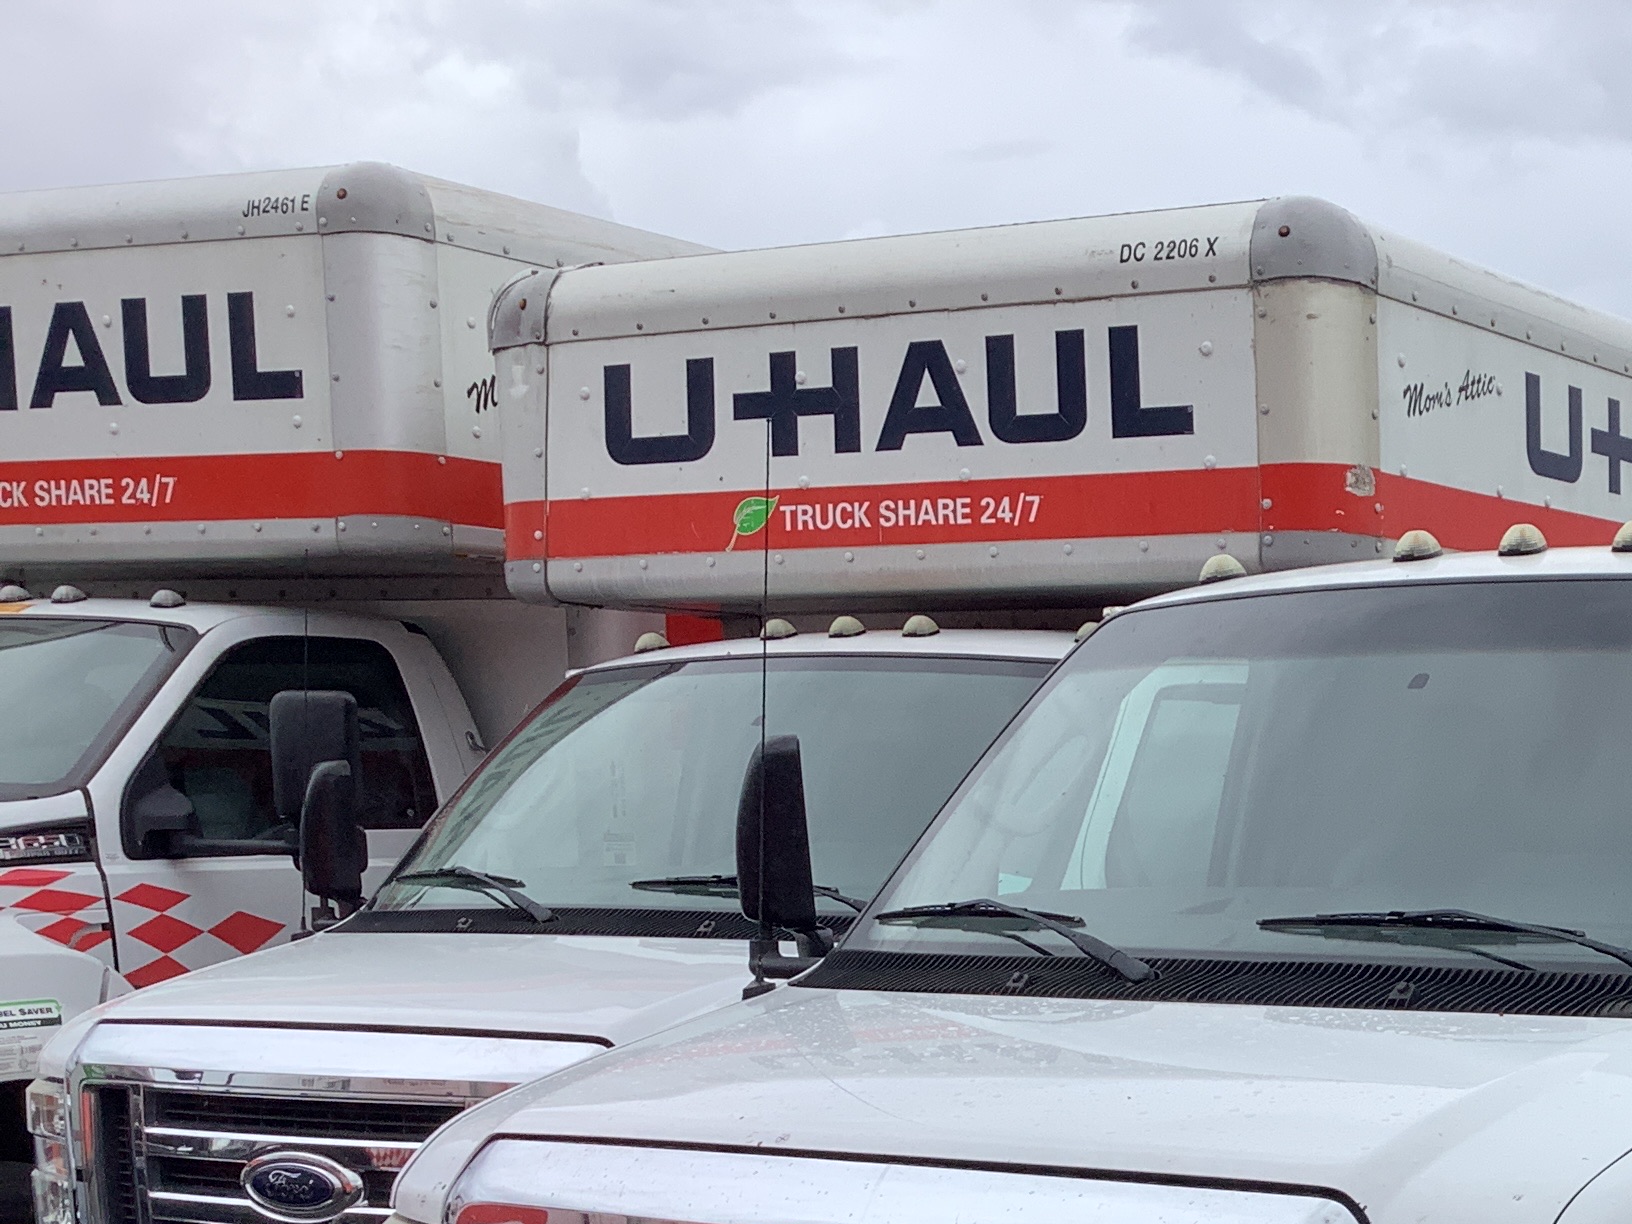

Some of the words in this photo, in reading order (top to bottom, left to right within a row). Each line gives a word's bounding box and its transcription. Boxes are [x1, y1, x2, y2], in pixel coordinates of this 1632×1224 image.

[301, 194, 310, 212] E
[1119, 241, 1146, 264] DC
[1153, 237, 1199, 261] 2206
[1205, 236, 1219, 257] X
[0, 291, 304, 411] AUL
[603, 325, 1195, 466] U-HAUL
[1403, 382, 1452, 418] Mom's
[1456, 369, 1495, 406] Attic
[34, 478, 115, 507] SHARE
[120, 473, 178, 508] 24/7
[779, 501, 872, 531] TRUCK
[878, 497, 972, 528] SHARE
[980, 492, 1041, 527] 24/7
[9, 1020, 42, 1028] MONEY
[18, 1007, 53, 1016] SAVER
